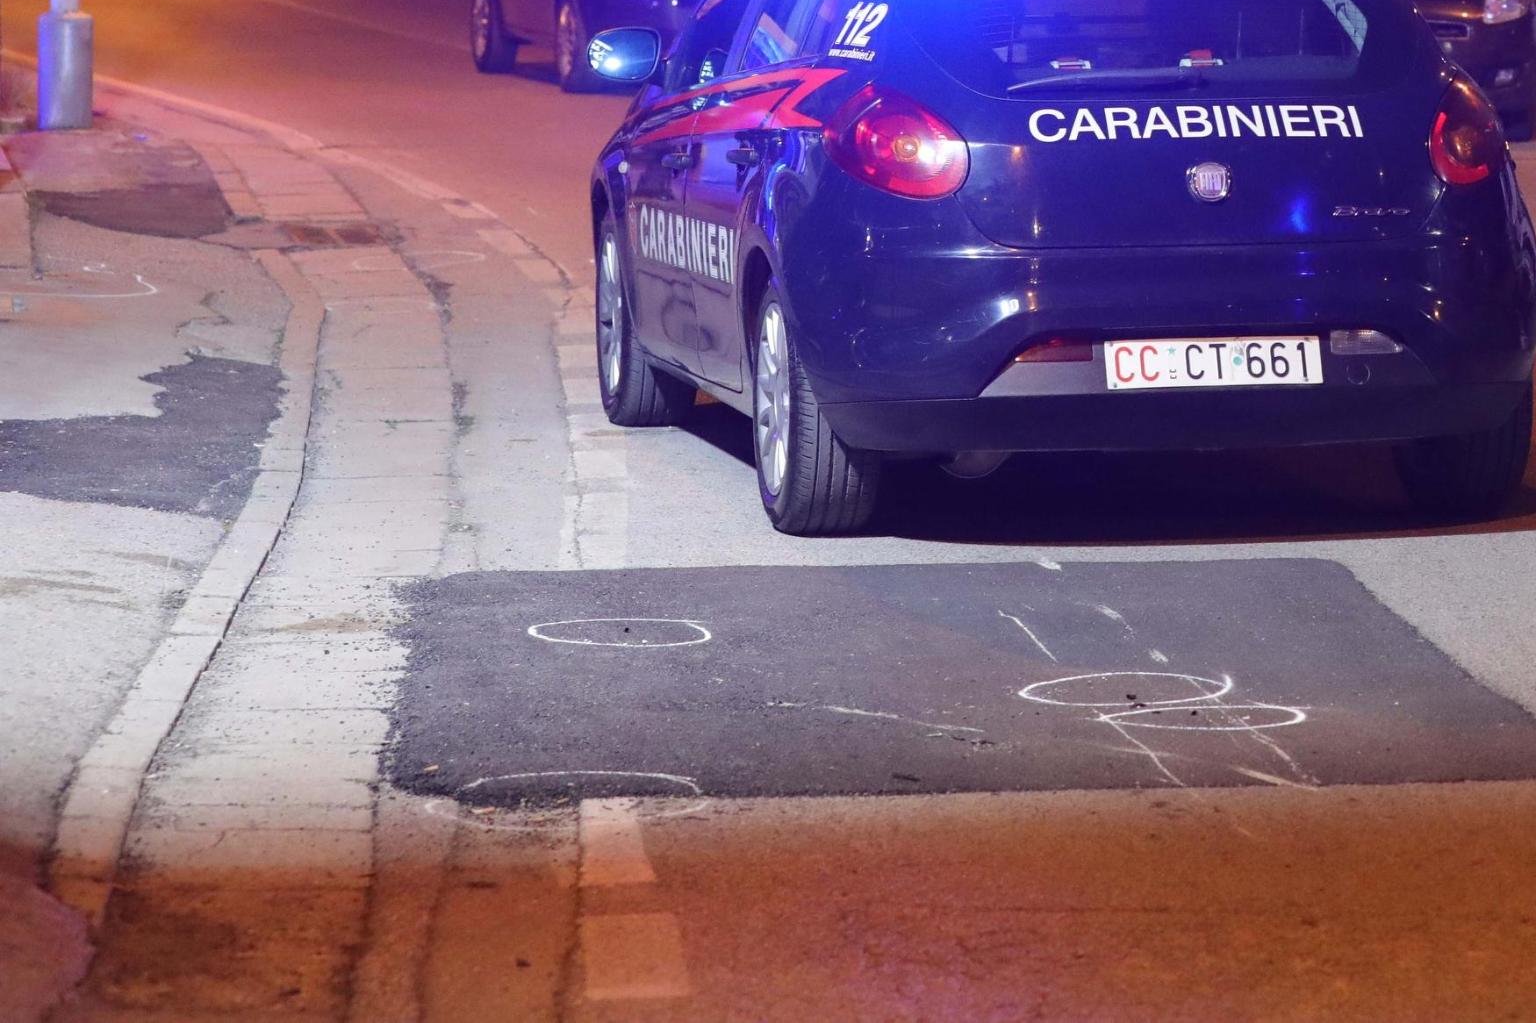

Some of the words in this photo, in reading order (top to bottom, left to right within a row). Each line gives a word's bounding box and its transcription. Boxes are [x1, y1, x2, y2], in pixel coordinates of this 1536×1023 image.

[835, 1, 889, 47] 112
[828, 48, 876, 62] www.carabinieri.it
[1028, 104, 1364, 143] CARABINIERI
[639, 204, 735, 284] CARABINIERI
[1114, 345, 1160, 383] CC
[1185, 343, 1228, 380] CT
[1246, 341, 1309, 378] 661
